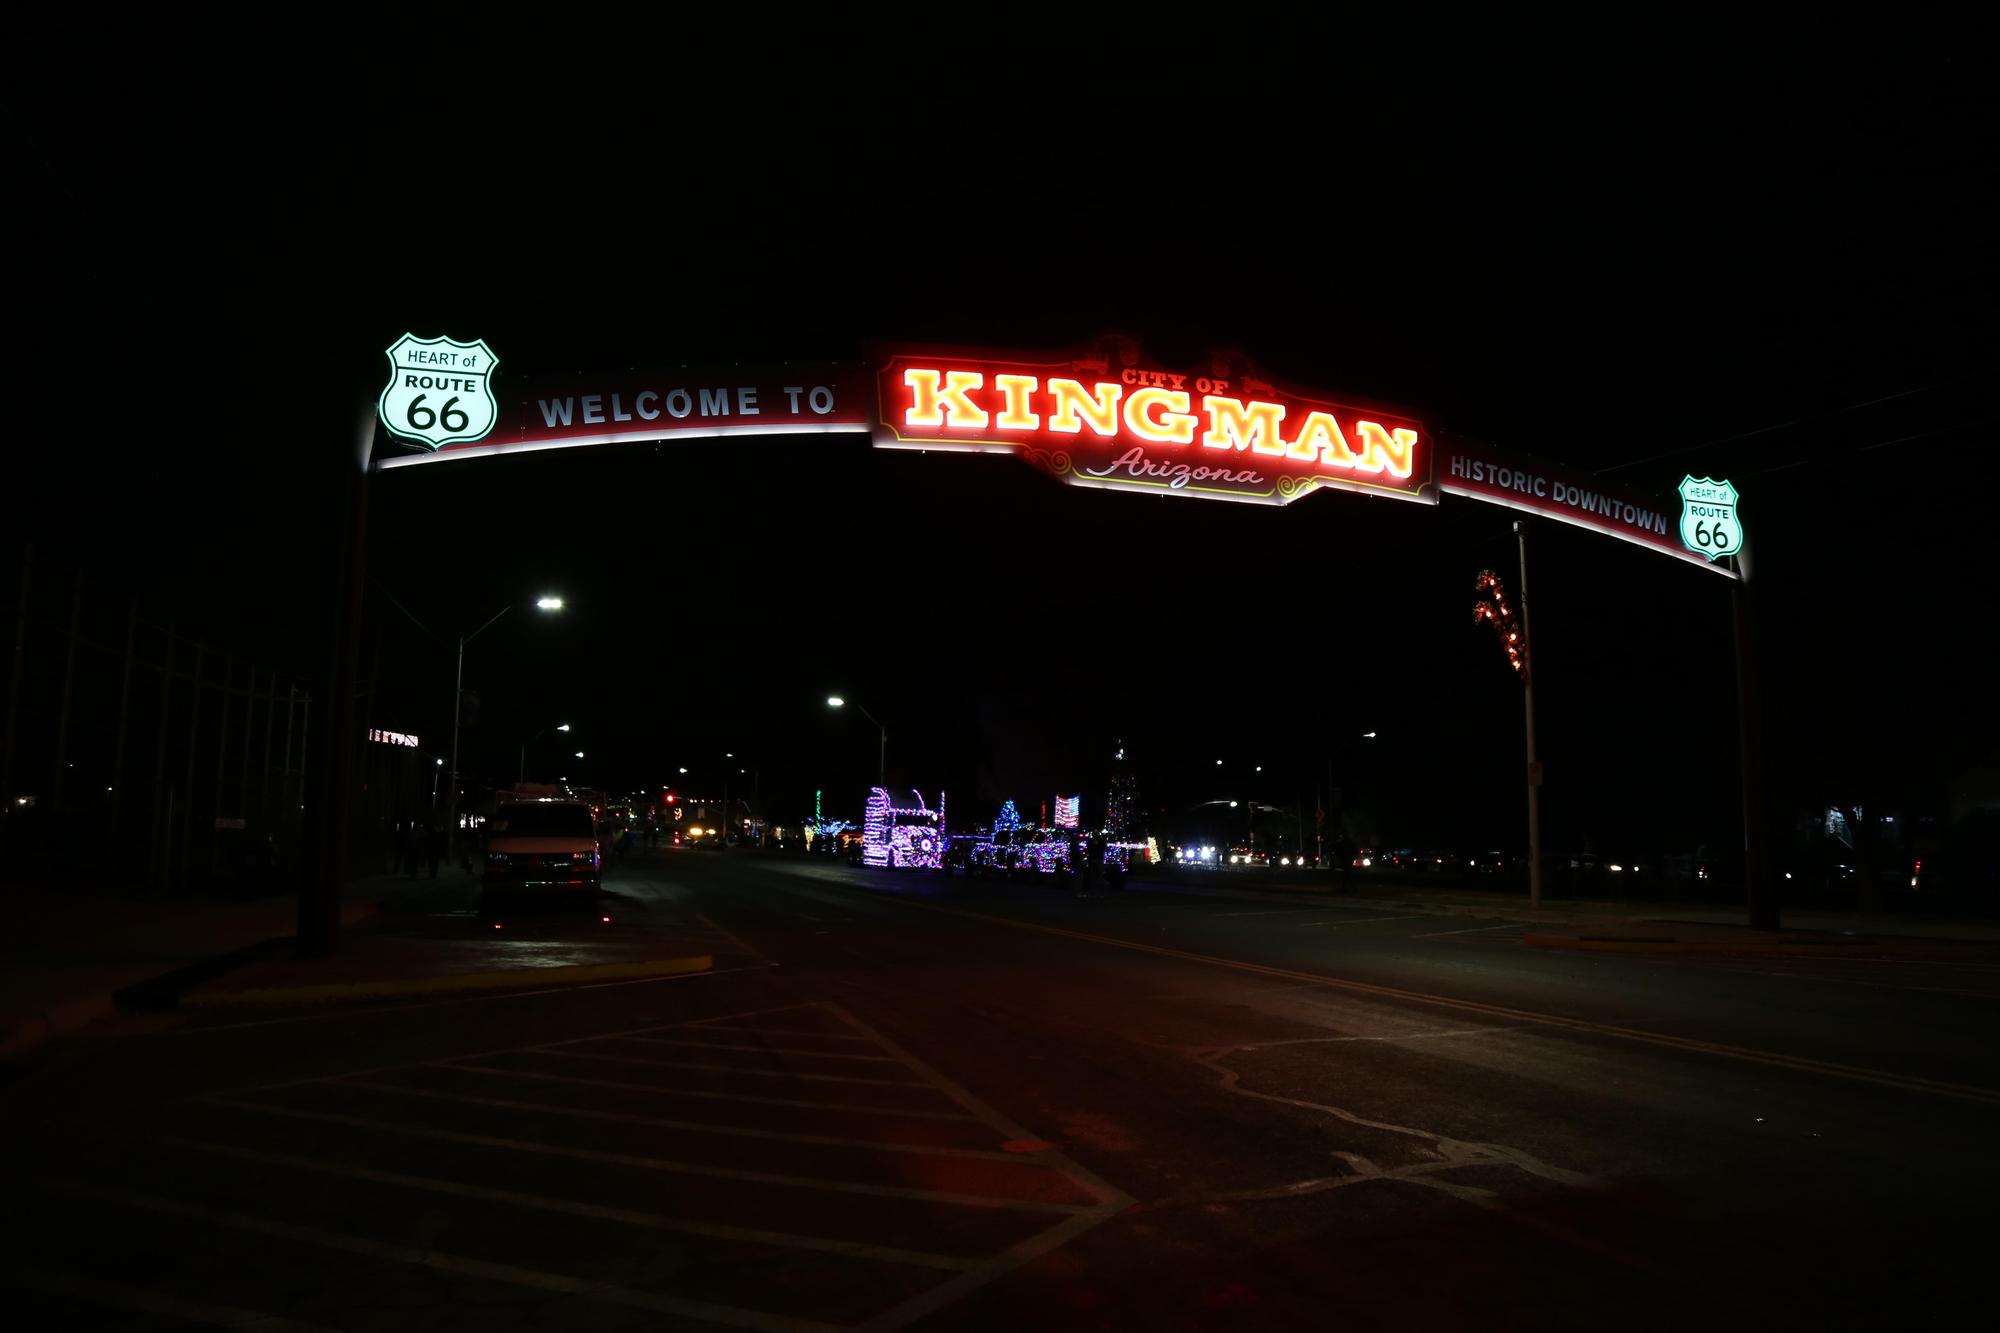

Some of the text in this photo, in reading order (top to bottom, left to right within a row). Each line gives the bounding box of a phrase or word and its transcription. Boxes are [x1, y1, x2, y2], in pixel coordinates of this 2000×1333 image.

[407, 350, 477, 368] HEART of
[405, 375, 476, 393] ROUTE
[1121, 368, 1229, 395] CITY OF
[406, 393, 470, 433] 66
[538, 386, 835, 428] WELCOME TO
[903, 367, 1418, 479] KINGMAN
[1086, 446, 1264, 489] Arizona
[1451, 455, 1668, 535] HISTORIC DOWNTOWN
[1690, 487, 1727, 501] HEART of
[1691, 505, 1729, 520] ROUTE
[1695, 520, 1729, 549] 66
